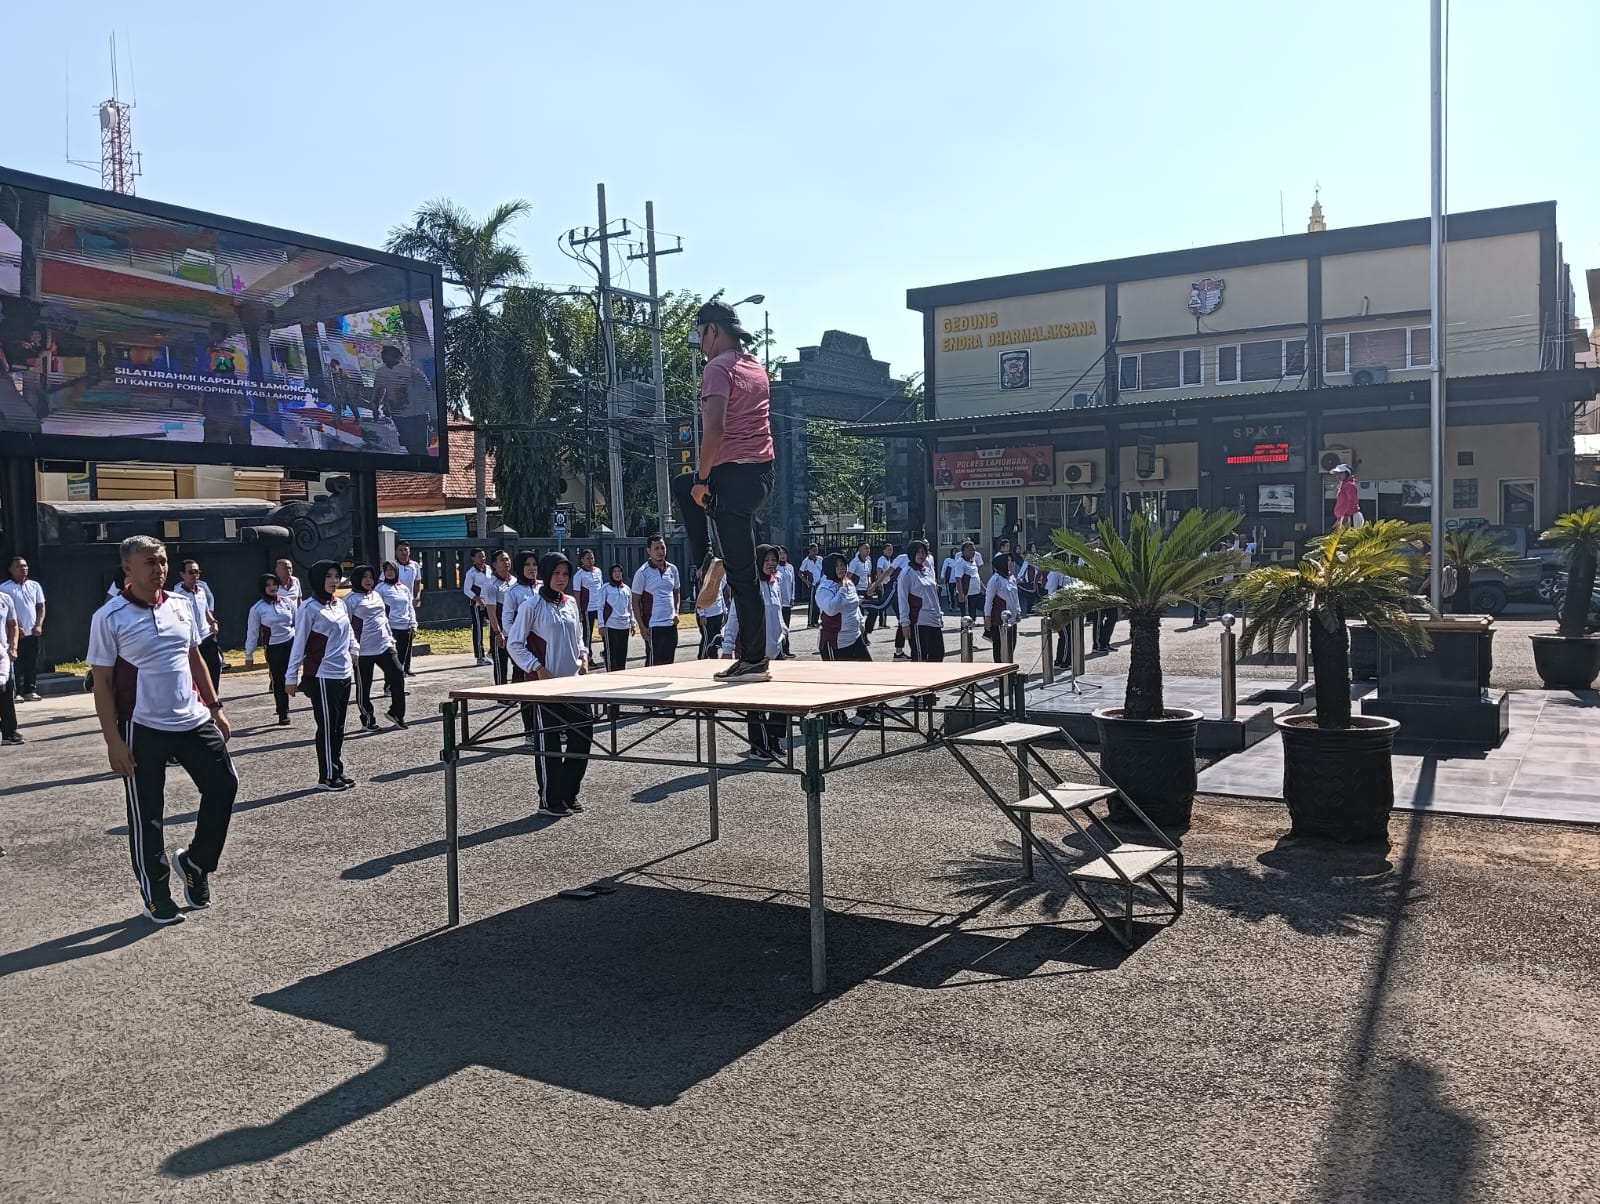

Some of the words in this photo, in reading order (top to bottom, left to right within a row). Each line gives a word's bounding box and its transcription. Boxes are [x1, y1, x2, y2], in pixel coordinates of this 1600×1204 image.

[943, 311, 999, 334] GEDUNG
[942, 335, 983, 352] ENDRA
[987, 320, 1097, 347] DHARMALAKSANA
[114, 366, 197, 382] SILATURAHMI
[199, 375, 258, 389] KAPOLRES
[260, 382, 319, 395] LAMONGAN
[115, 377, 127, 385] DI
[130, 379, 174, 389] KANTOR
[176, 383, 244, 396] FORKOPIMDA
